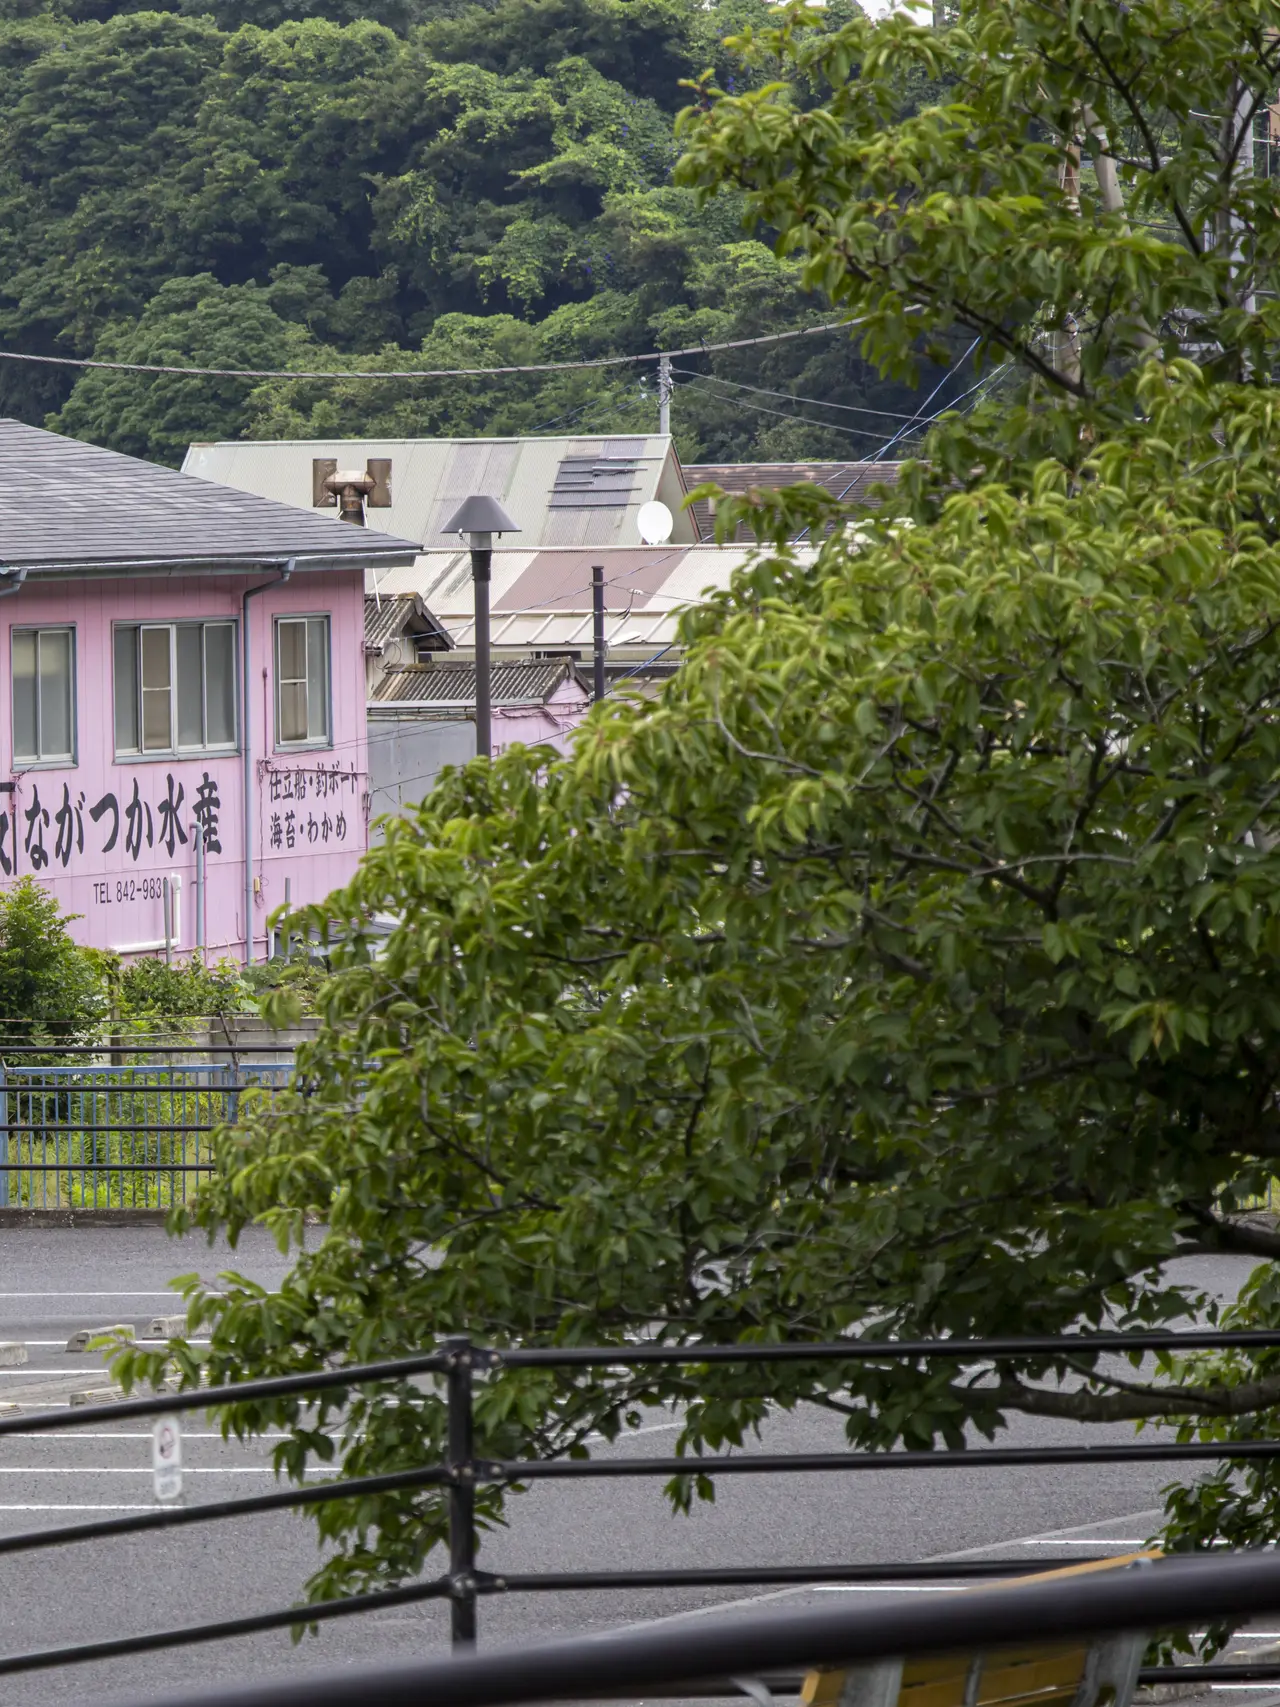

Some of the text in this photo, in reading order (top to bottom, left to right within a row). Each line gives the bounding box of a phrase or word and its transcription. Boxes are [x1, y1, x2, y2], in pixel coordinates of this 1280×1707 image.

[270, 810, 347, 849] 海苔・わかめ
[93, 882, 112, 904] TEL
